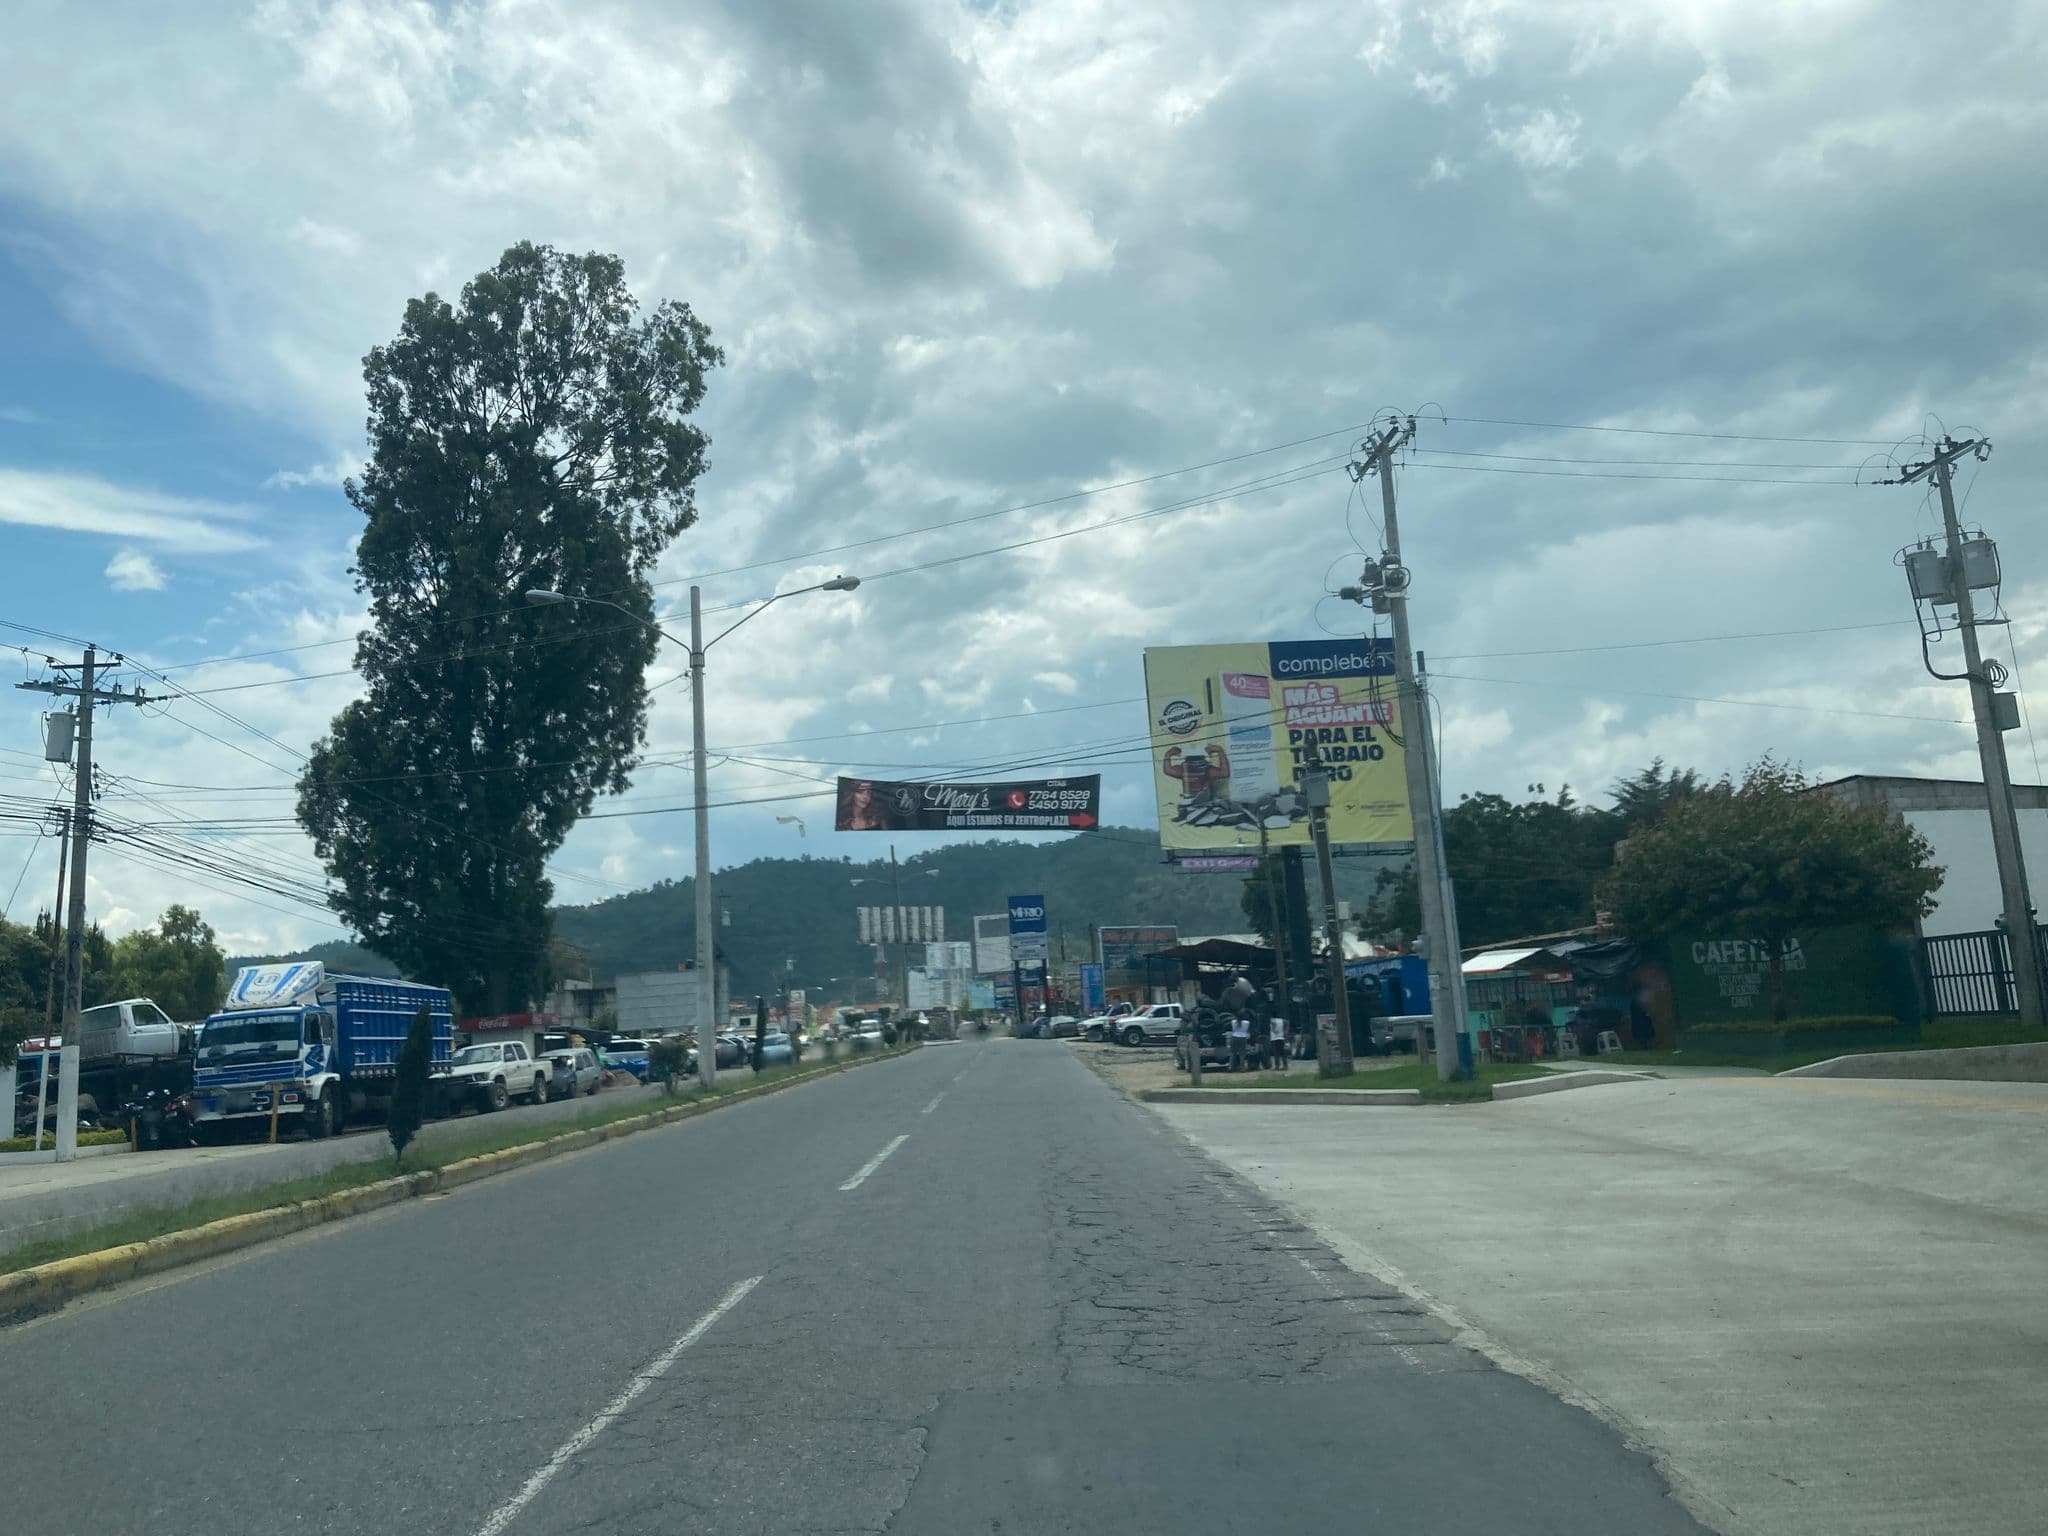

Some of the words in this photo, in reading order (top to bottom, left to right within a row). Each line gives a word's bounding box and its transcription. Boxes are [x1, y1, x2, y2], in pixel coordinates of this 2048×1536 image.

[1285, 684, 1336, 705] MÁS
[1287, 703, 1391, 724] AGUANTE
[1288, 727, 1348, 745] PARA
[1352, 726, 1376, 742] EL
[1290, 744, 1384, 764] TABAJO
[1028, 800, 1059, 810] 5450
[1060, 800, 1088, 810] 9173
[1029, 790, 1057, 801] 7764
[966, 815, 1003, 826] ESTAMOS
[1004, 815, 1014, 825] EN
[1691, 937, 1805, 964] CAFETEIA
